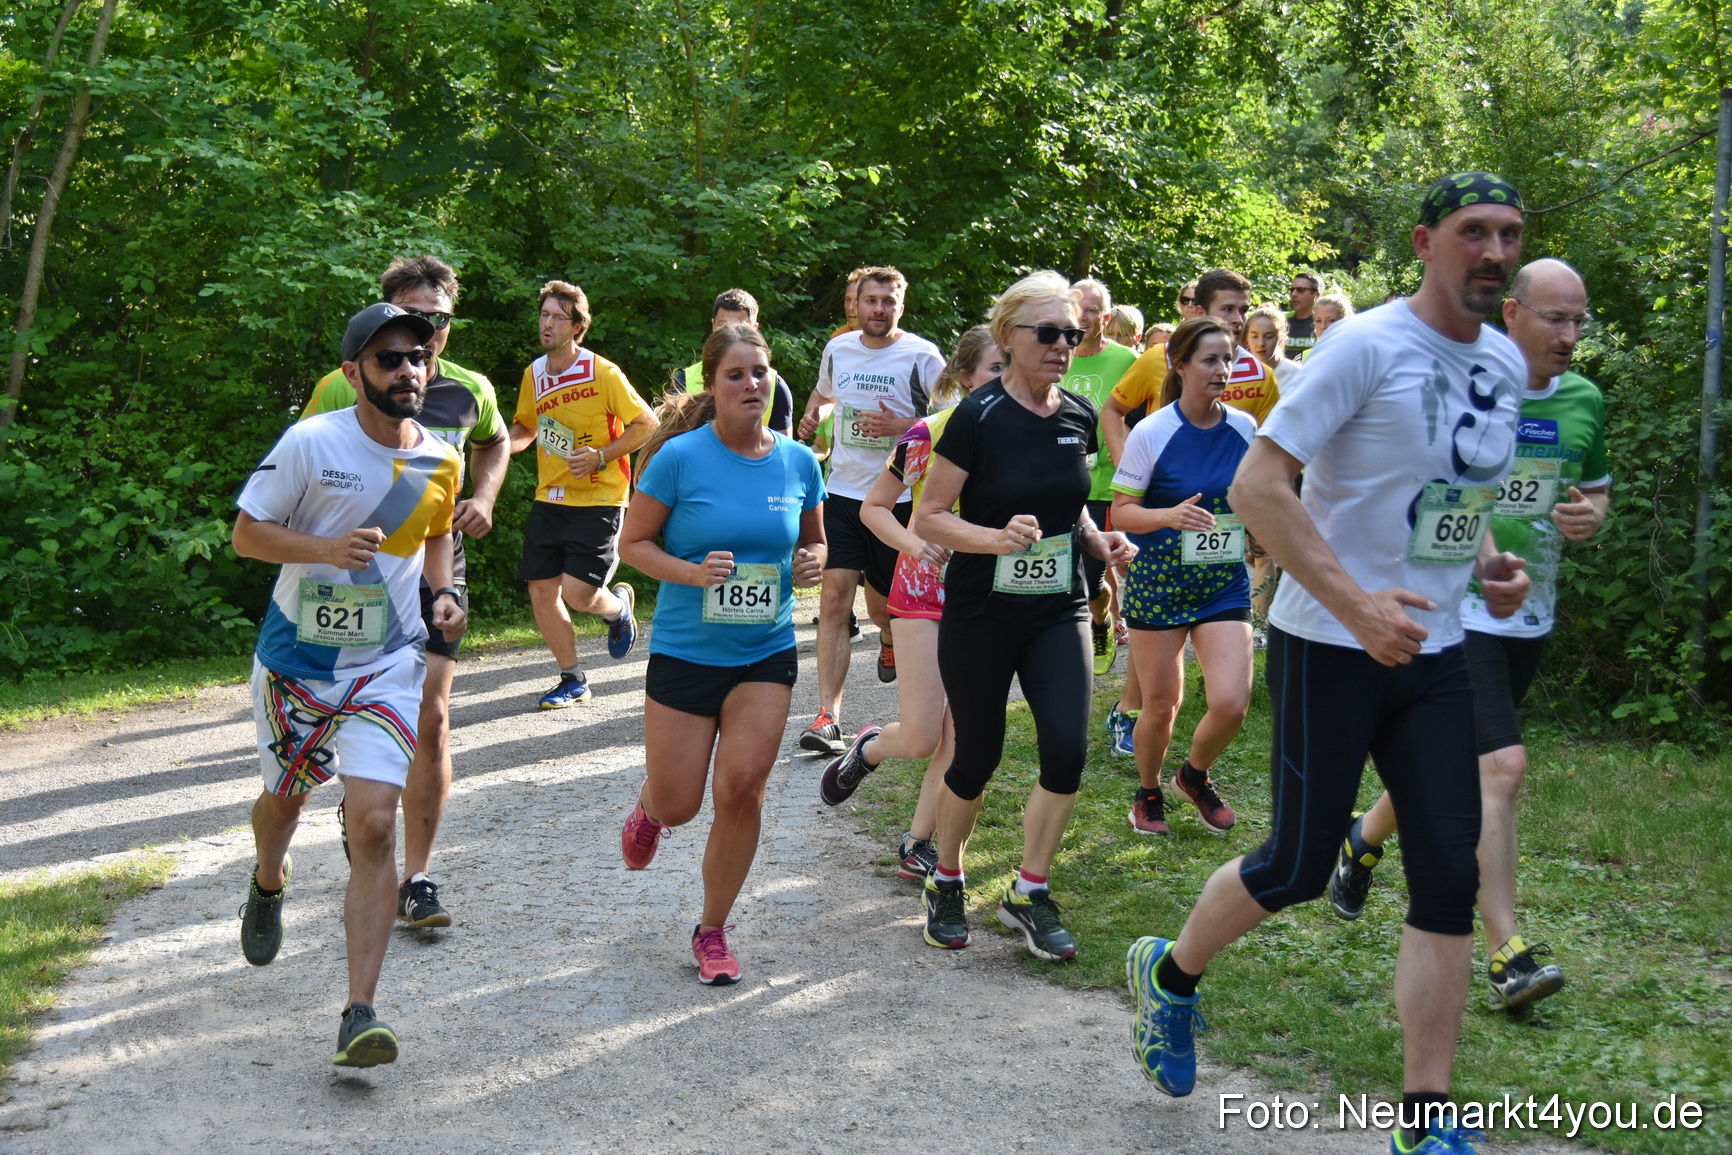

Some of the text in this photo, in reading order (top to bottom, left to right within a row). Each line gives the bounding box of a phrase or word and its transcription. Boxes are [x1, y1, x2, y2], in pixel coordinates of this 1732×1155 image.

[853, 373, 896, 386] HAUBNER
[856, 382, 889, 393] TREPPEN
[562, 387, 599, 404] BÖGL
[1220, 386, 1264, 402] BÖGL
[543, 428, 568, 451] 1572
[1057, 436, 1079, 444] THERESIA
[1524, 428, 1556, 436] Fischer
[320, 478, 353, 489] GROUP
[322, 469, 362, 482] DESSIGN
[1435, 513, 1480, 543] 680
[1196, 531, 1231, 550] 267
[1013, 558, 1057, 579] 953
[714, 584, 772, 607] 1854
[316, 605, 364, 630] 621
[317, 628, 346, 637] Kümmel
